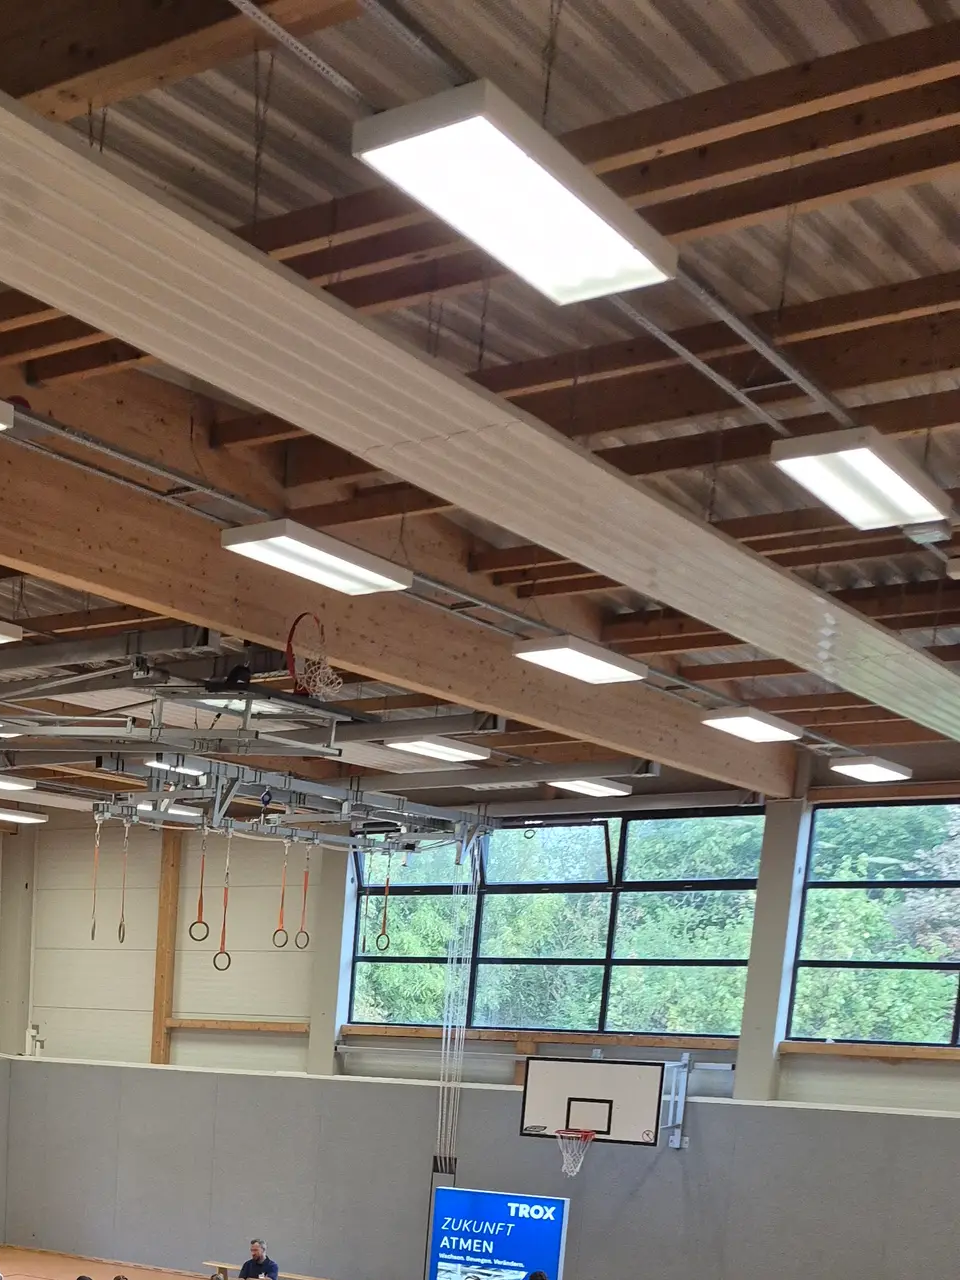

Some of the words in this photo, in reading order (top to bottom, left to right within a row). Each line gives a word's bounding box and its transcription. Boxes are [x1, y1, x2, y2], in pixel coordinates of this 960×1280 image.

[507, 1202, 557, 1220] TROX
[441, 1217, 516, 1236] ZUKUNFT
[440, 1236, 494, 1253] ATMEN
